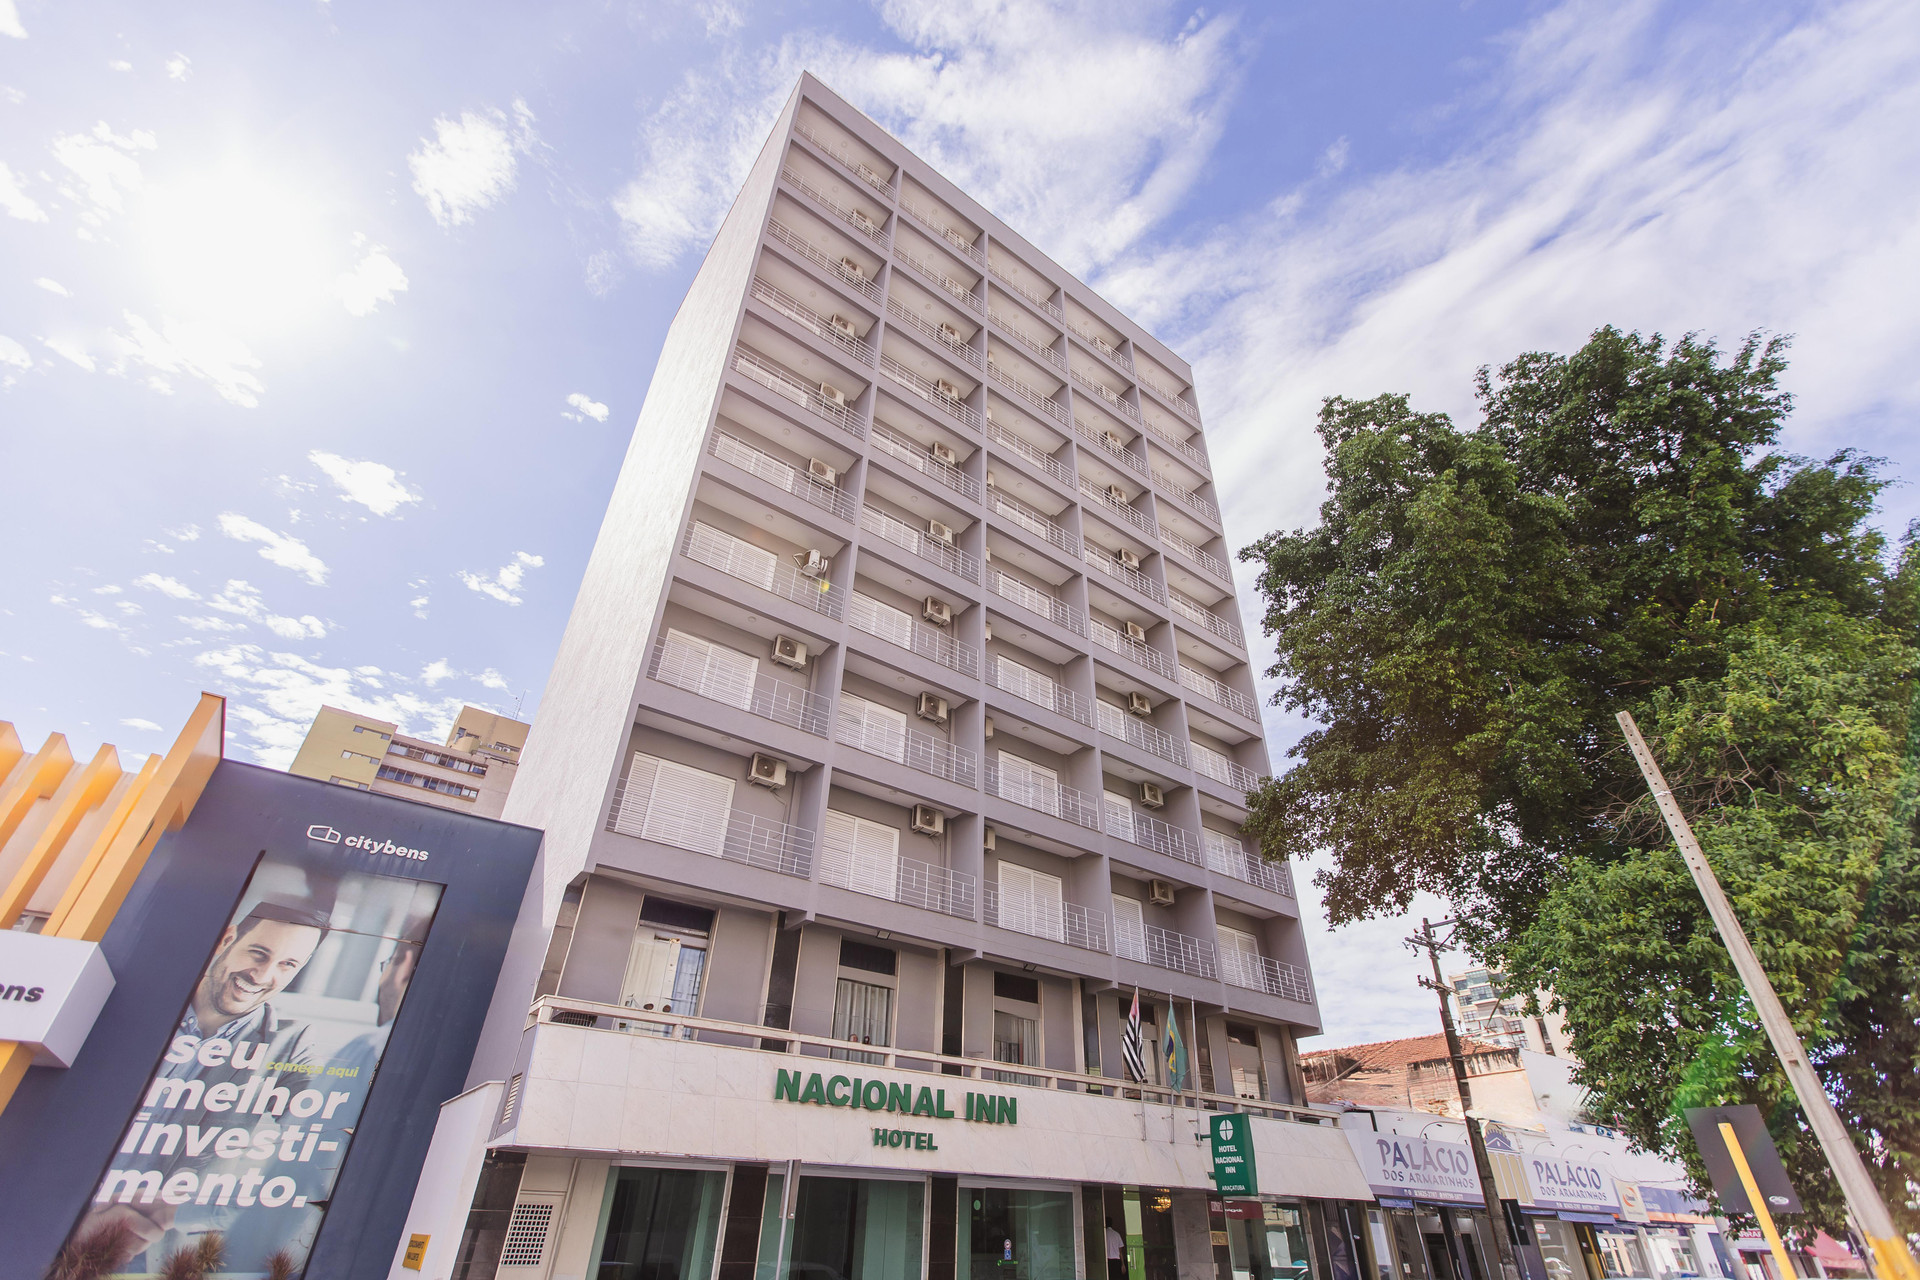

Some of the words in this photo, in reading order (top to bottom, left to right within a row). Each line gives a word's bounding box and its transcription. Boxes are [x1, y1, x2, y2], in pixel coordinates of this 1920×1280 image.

[344, 835, 429, 861] citybens
[164, 1034, 269, 1070] seu
[266, 1060, 324, 1076] começa
[327, 1064, 359, 1078] aqui
[142, 1075, 350, 1120] melhor
[775, 1068, 955, 1119] NACIONAL
[966, 1091, 1017, 1125] INN
[120, 1114, 339, 1163] investi-
[873, 1127, 938, 1151] HOTEL
[1218, 1145, 1238, 1153] HOTEL
[1215, 1156, 1244, 1164] NACIONAL
[1225, 1166, 1236, 1174] INN
[1376, 1138, 1469, 1176] PALÁCIO
[97, 1168, 308, 1208] mento.
[1383, 1169, 1405, 1182] DOS
[1408, 1172, 1475, 1189] ARMARINHOS
[1533, 1160, 1602, 1190] PALÁCIO
[1540, 1186, 1557, 1197] DOS
[1559, 1187, 1608, 1201] ARMARINHOS
